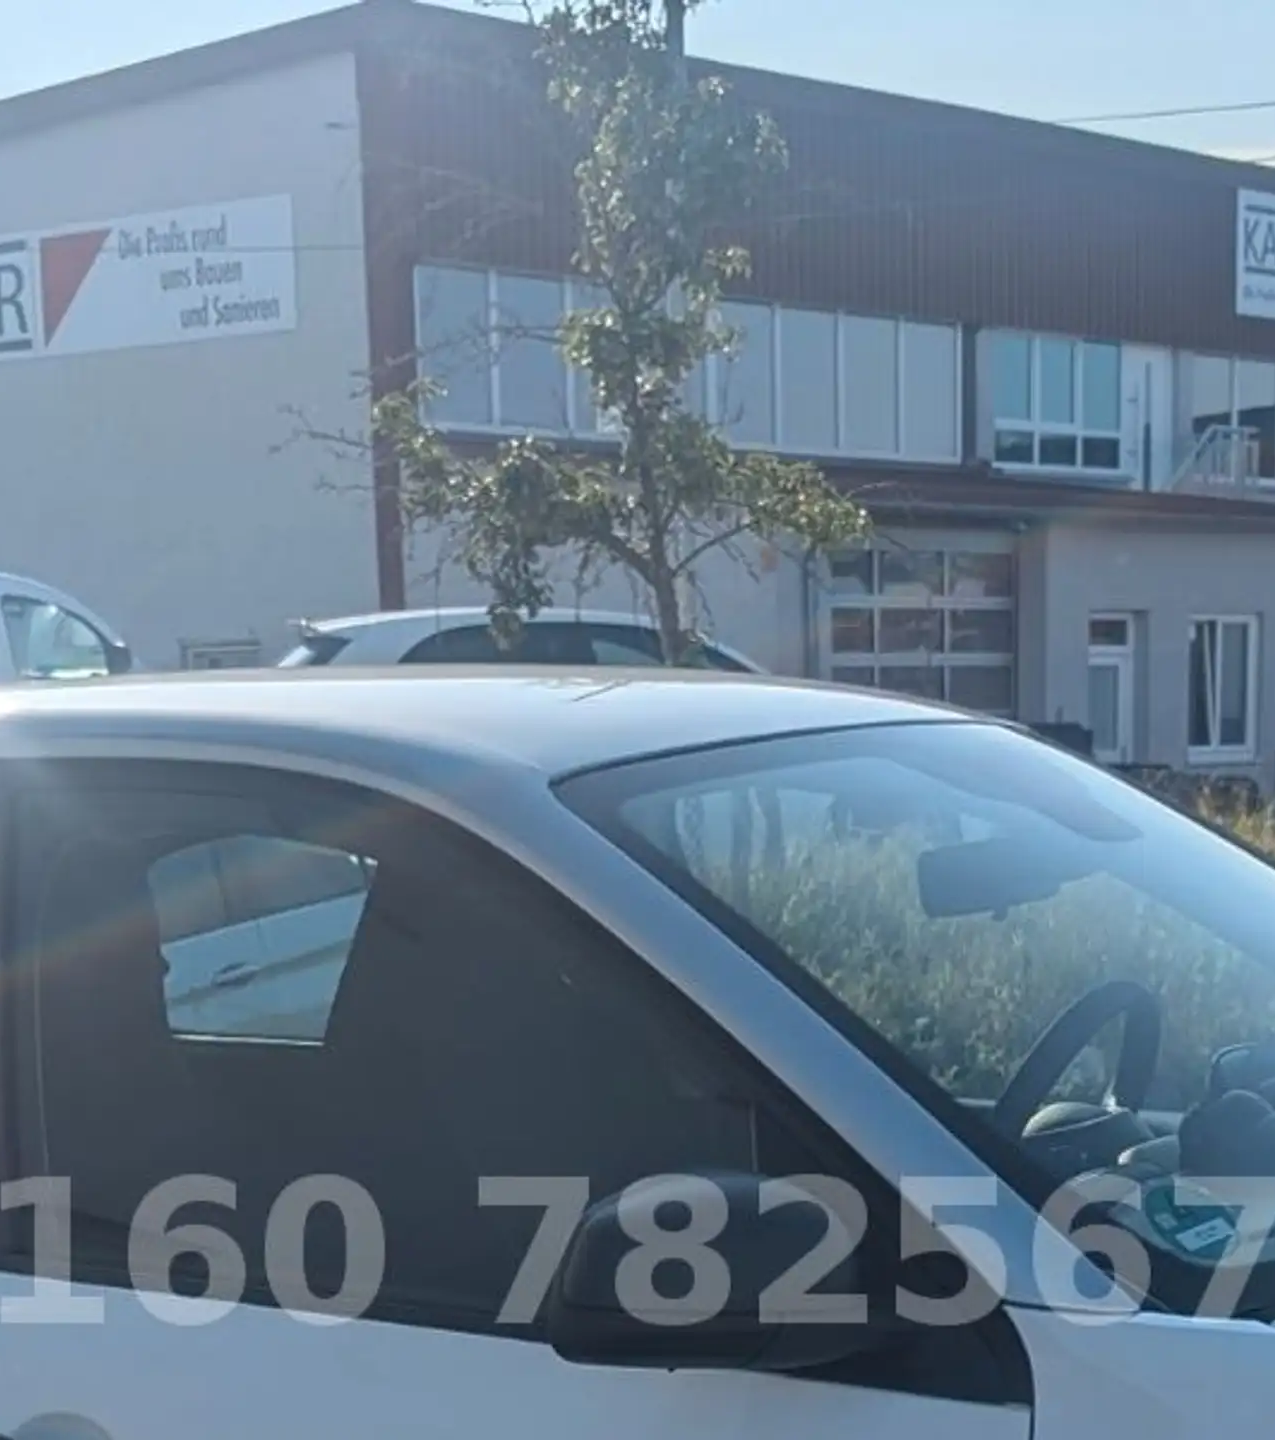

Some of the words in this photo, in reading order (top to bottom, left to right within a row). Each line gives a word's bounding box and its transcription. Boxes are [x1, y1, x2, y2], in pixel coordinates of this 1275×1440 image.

[192, 213, 227, 251] rund
[180, 295, 209, 328] und
[213, 294, 281, 326] Sanieren
